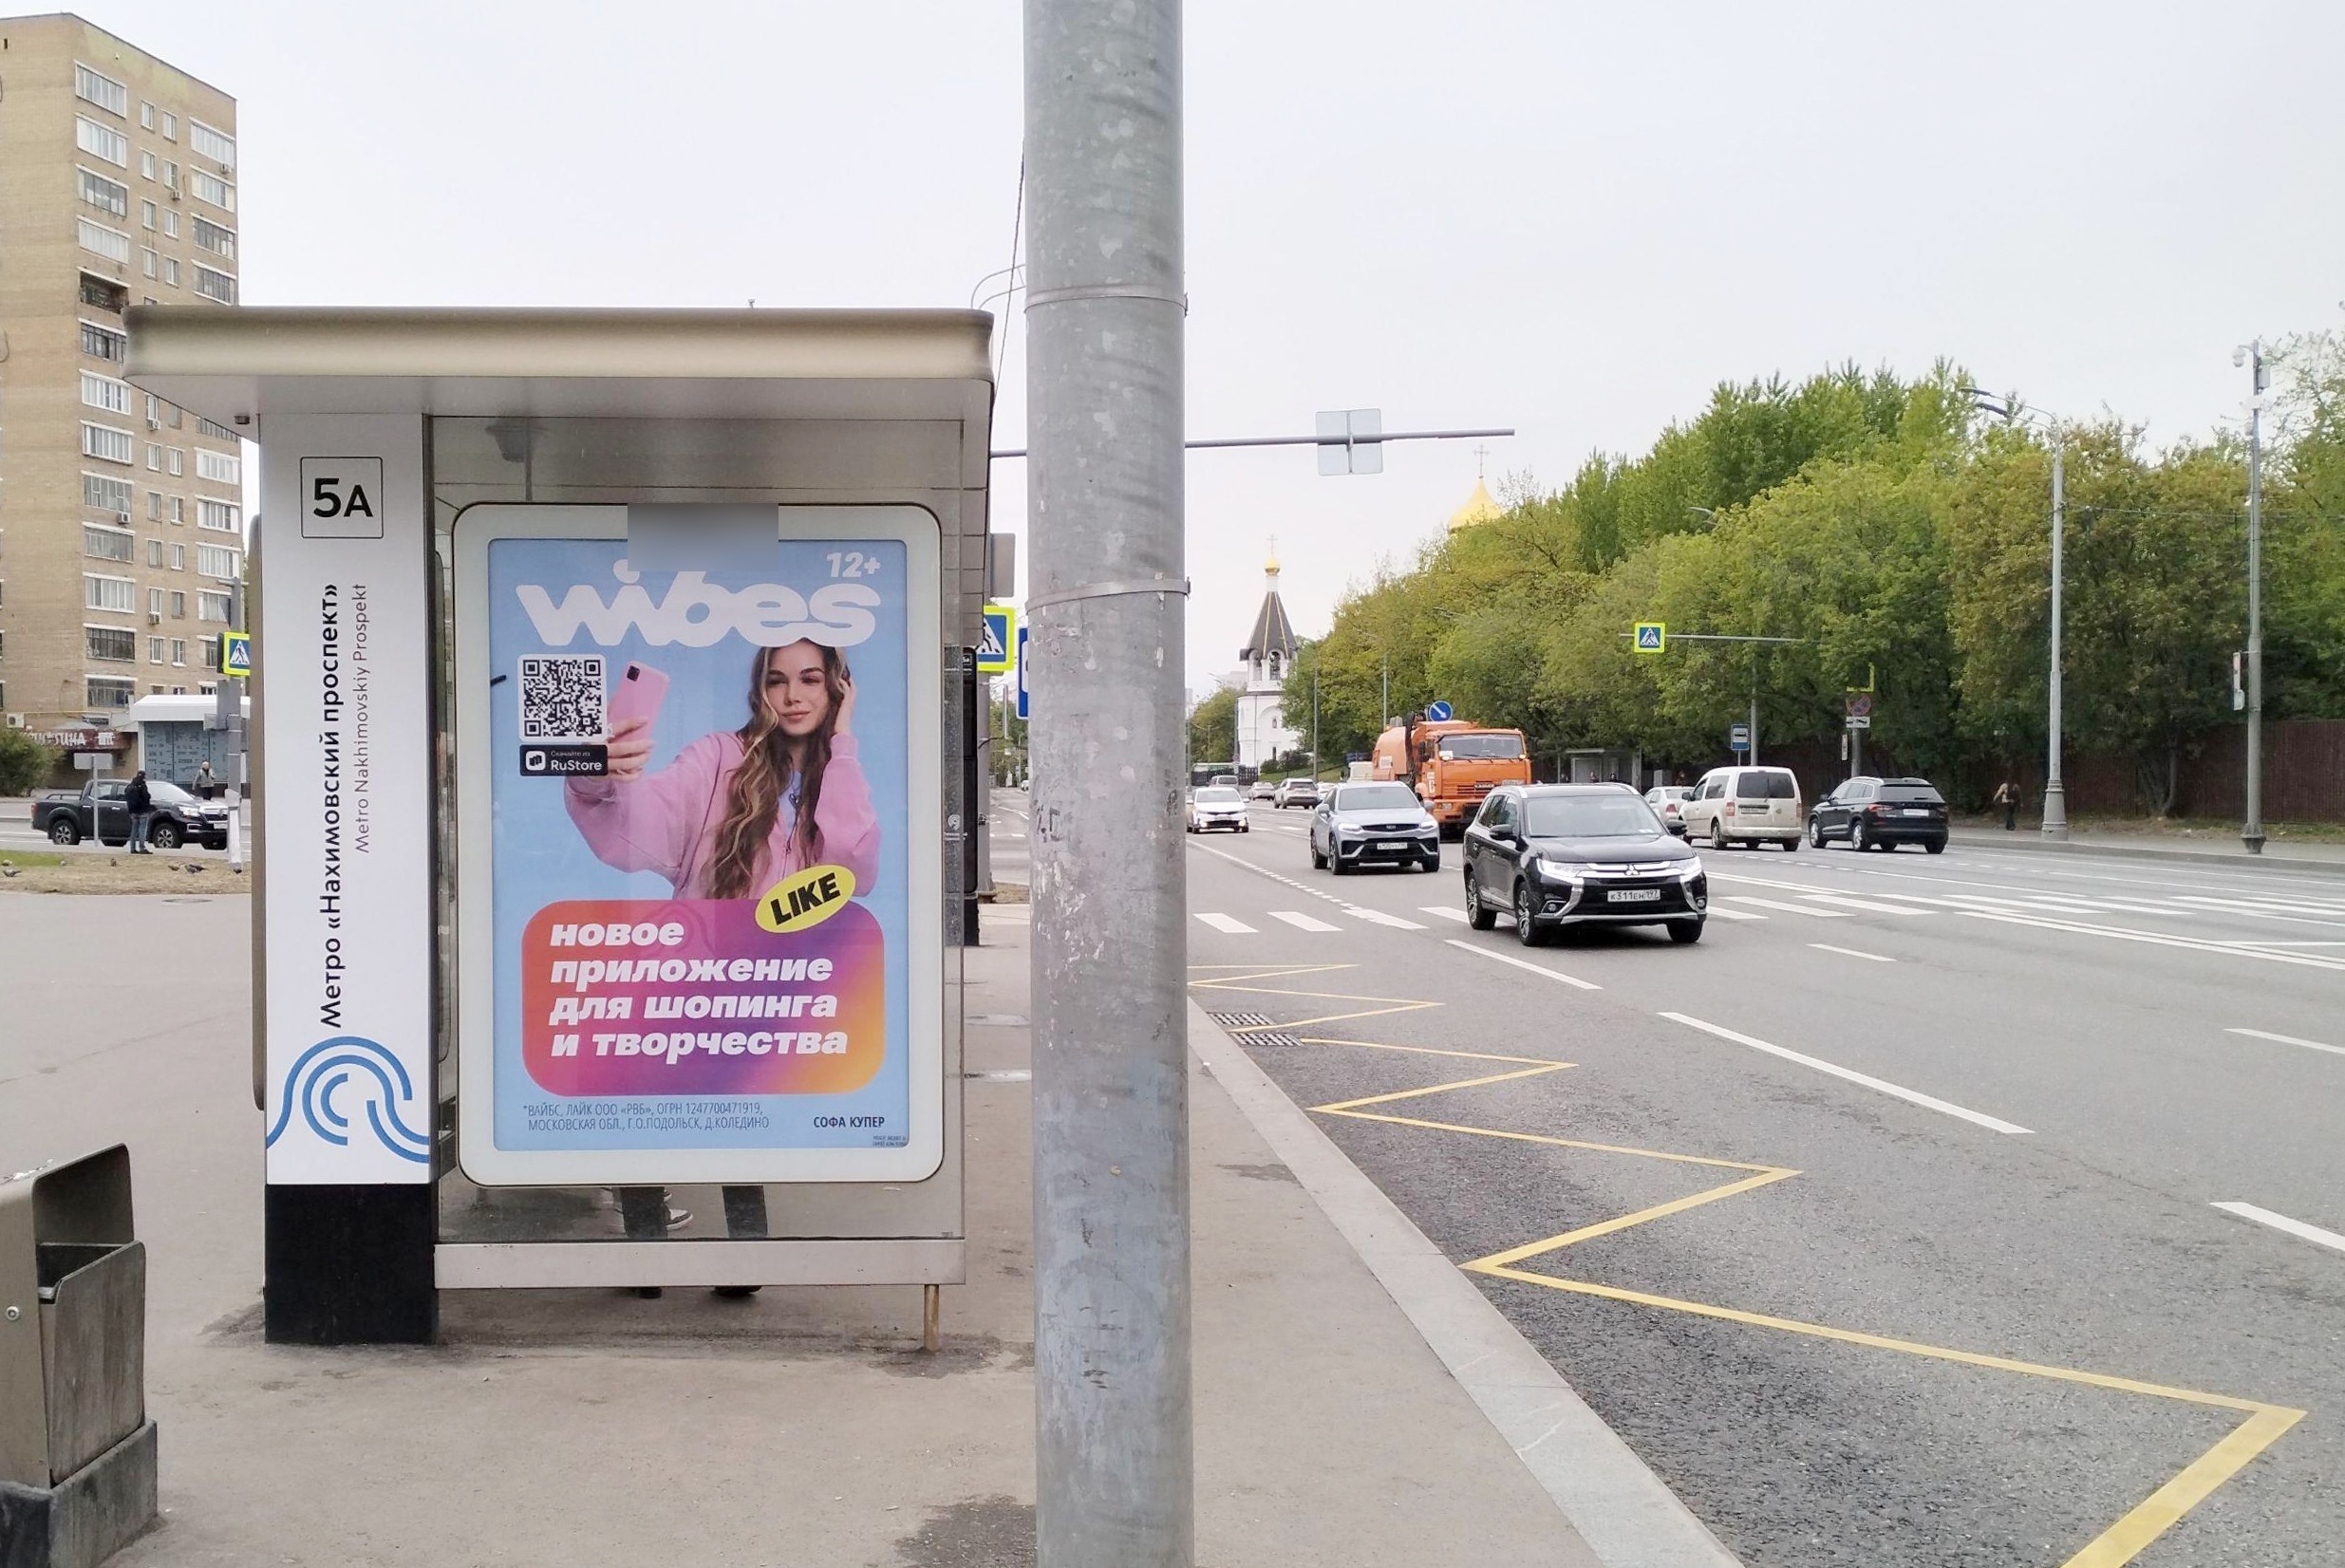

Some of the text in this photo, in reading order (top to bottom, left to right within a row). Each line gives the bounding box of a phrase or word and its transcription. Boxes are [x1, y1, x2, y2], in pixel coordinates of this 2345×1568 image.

[825, 551, 881, 578] 12+
[351, 583, 370, 853] Metro Nakhimovskiy Prospekt
[551, 760, 603, 771] RuStore
[318, 584, 346, 1029] Метро «Нахимовский проспект»
[770, 871, 841, 926] LIKE
[550, 922, 685, 947] новое
[550, 958, 834, 993] приложение
[548, 994, 838, 1026] для шопинга
[551, 1031, 849, 1065] и творчества
[566, 1102, 592, 1115] ЛАЙК
[595, 1103, 618, 1115] ООО
[657, 1102, 683, 1115] ОГРН
[813, 1115, 885, 1129] СОФА КУПЕР
[528, 1119, 596, 1131] МОСКОВСКАЯ
